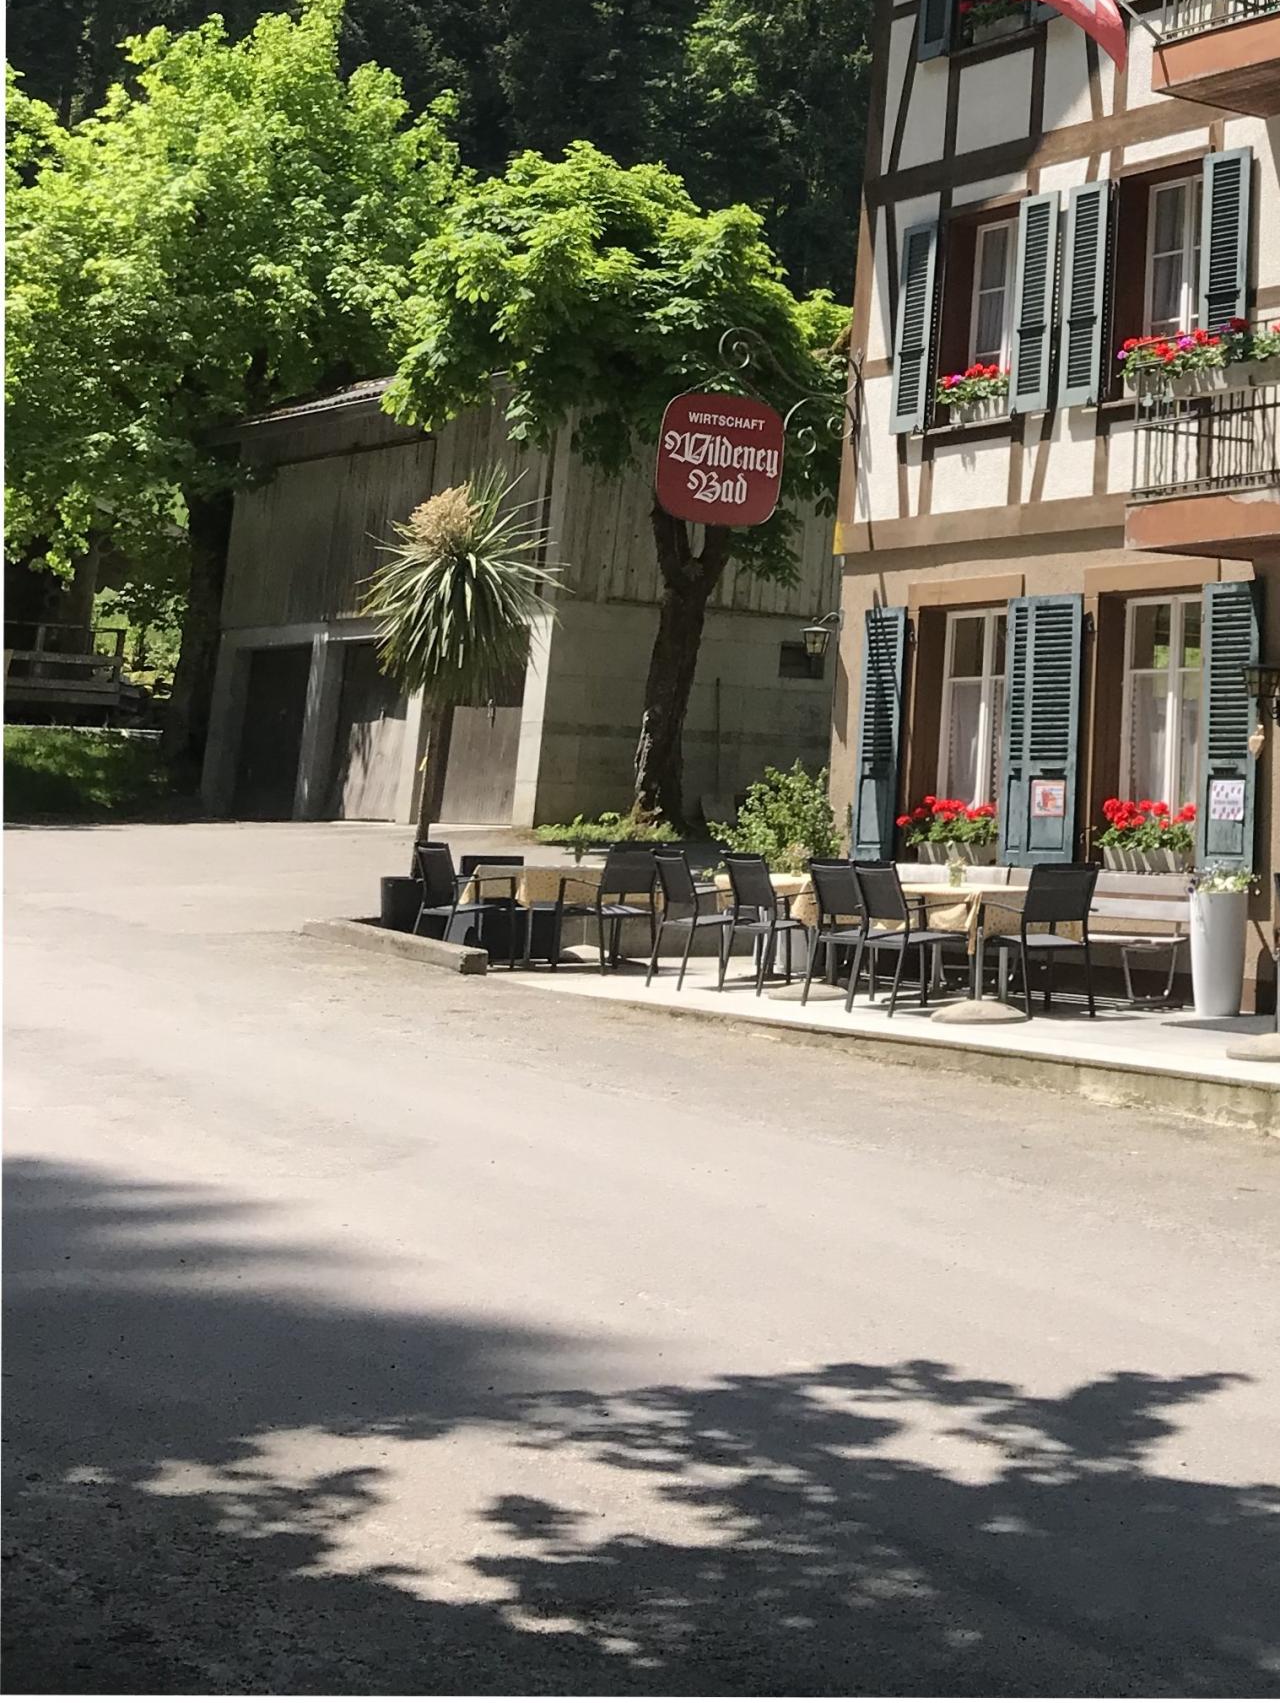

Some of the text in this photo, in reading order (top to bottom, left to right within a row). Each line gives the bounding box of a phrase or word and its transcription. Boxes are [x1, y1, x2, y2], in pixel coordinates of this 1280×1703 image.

[688, 411, 766, 431] WIRTSCHAFT
[664, 430, 779, 478] Wildeney
[686, 468, 748, 505] Bad
